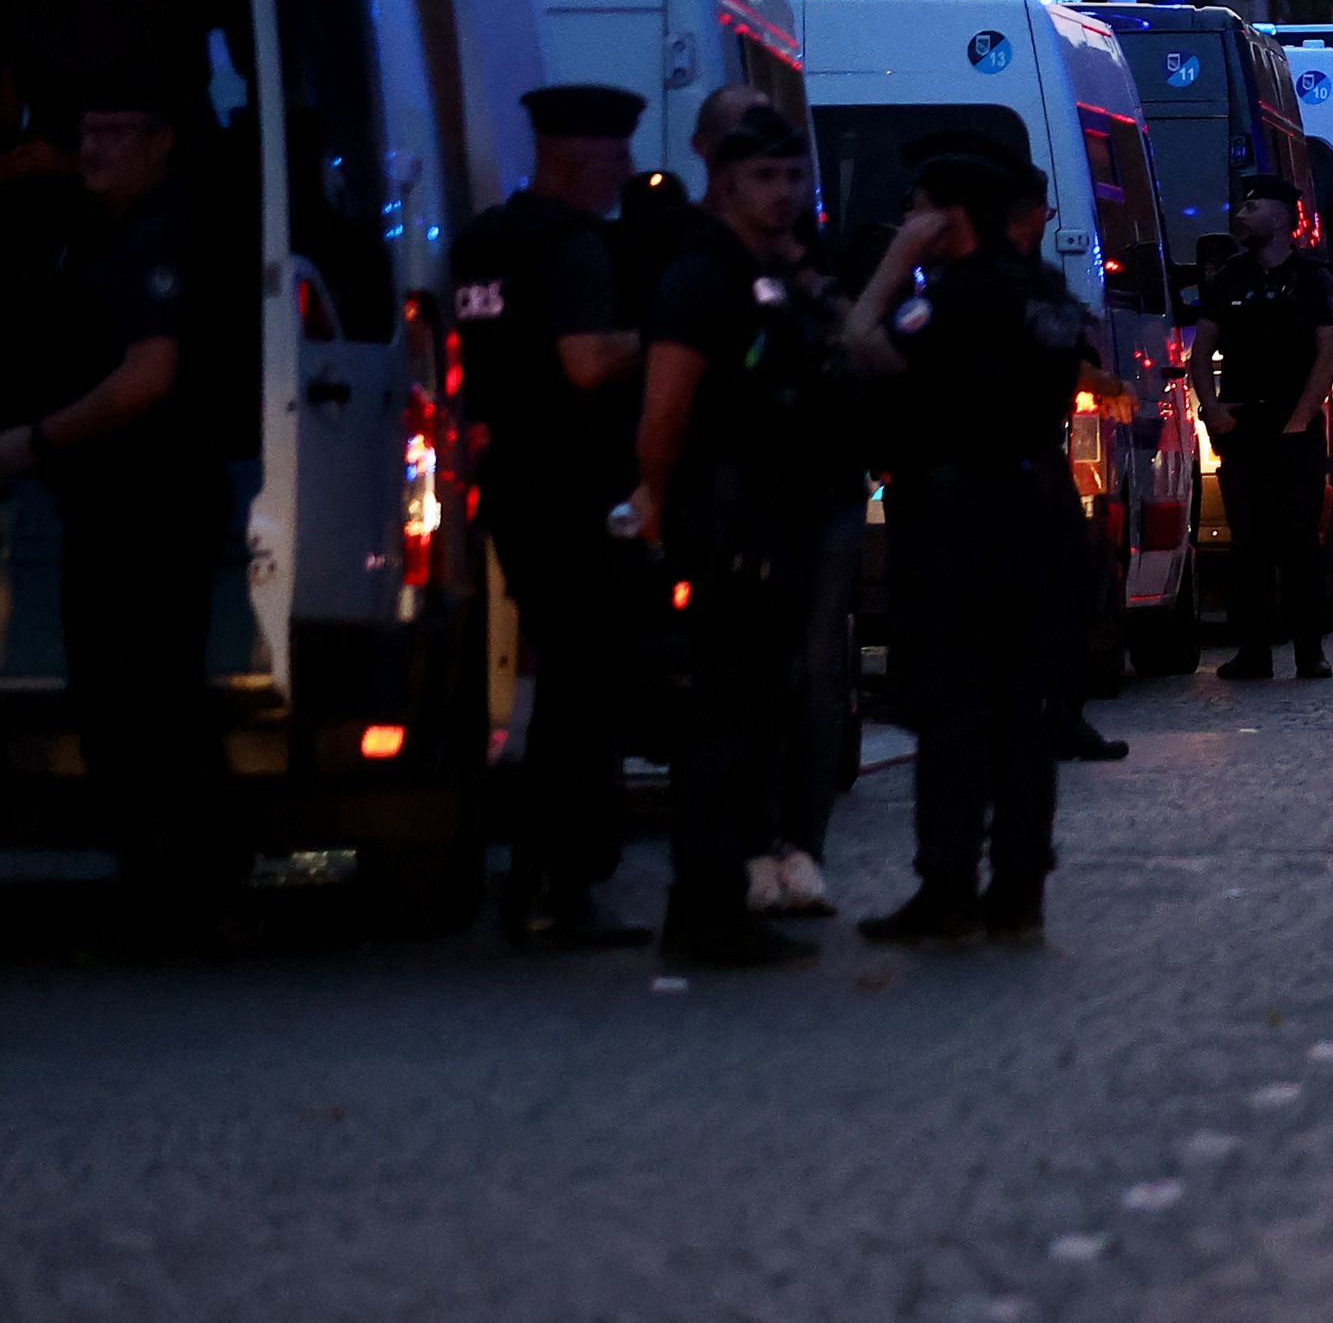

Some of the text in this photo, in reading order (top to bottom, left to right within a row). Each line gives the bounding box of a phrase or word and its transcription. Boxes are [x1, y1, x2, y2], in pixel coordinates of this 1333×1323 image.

[989, 52, 1005, 68] 13
[1179, 68, 1194, 81] 11
[1313, 86, 1328, 100] 10
